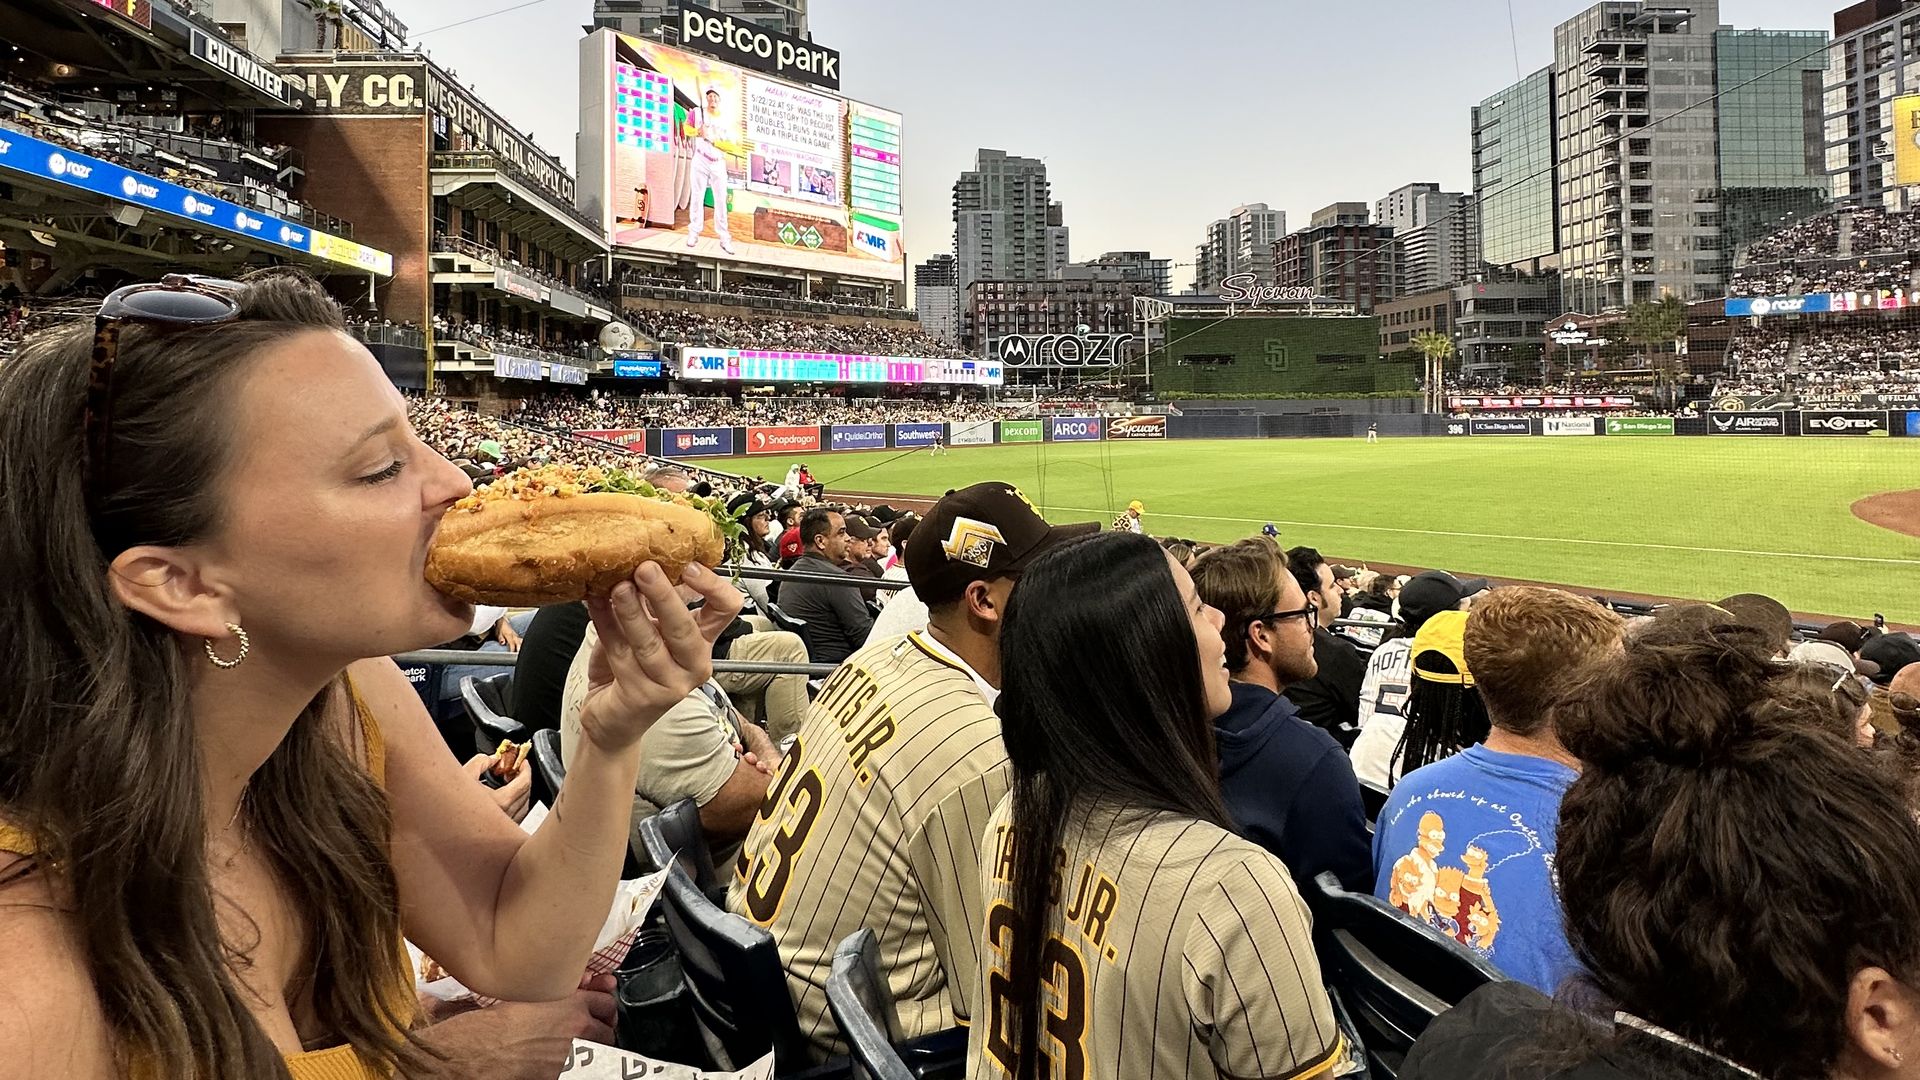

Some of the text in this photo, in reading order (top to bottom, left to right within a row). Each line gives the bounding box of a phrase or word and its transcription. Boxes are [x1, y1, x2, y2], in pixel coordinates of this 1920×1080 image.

[683, 9, 838, 80] petco park
[208, 38, 284, 99] CUTWATER
[362, 74, 423, 108] CO.
[778, 101, 785, 109] AT
[797, 107, 812, 117] WAS
[813, 110, 824, 119] THE
[752, 104, 834, 132] IN ML HISTORY TO RECORD
[428, 73, 488, 142] WESTERN
[492, 128, 526, 171] METAL
[527, 151, 562, 199] SUPPLY
[756, 125, 770, 136] AND
[778, 130, 799, 142] TRIPLE
[66, 161, 93, 179] razr
[137, 183, 160, 198] razr
[196, 202, 216, 216] razr
[246, 218, 264, 231] razr
[1219, 272, 1318, 308] Sycuan
[1771, 298, 1806, 311] razr
[1033, 333, 1134, 367] razr
[687, 356, 725, 370] AMR
[1799, 394, 1862, 403] TEMPLETON
[1054, 422, 1087, 436] ARCO
[1110, 418, 1161, 437] Sycuan
[1448, 424, 1464, 434] 396
[1494, 423, 1508, 431] Diego
[1636, 423, 1655, 432] Diego
[1809, 416, 1878, 430] EVOTEK
[678, 433, 719, 447] us bank
[768, 434, 816, 447] Snapdragon
[898, 430, 936, 441] Southwest
[402, 667, 427, 676] etco
[407, 674, 427, 682] ark
[845, 702, 897, 788] JR.
[1491, 803, 1508, 813] at
[993, 824, 1120, 964] TAS JR.
[982, 900, 1094, 1080] 23
